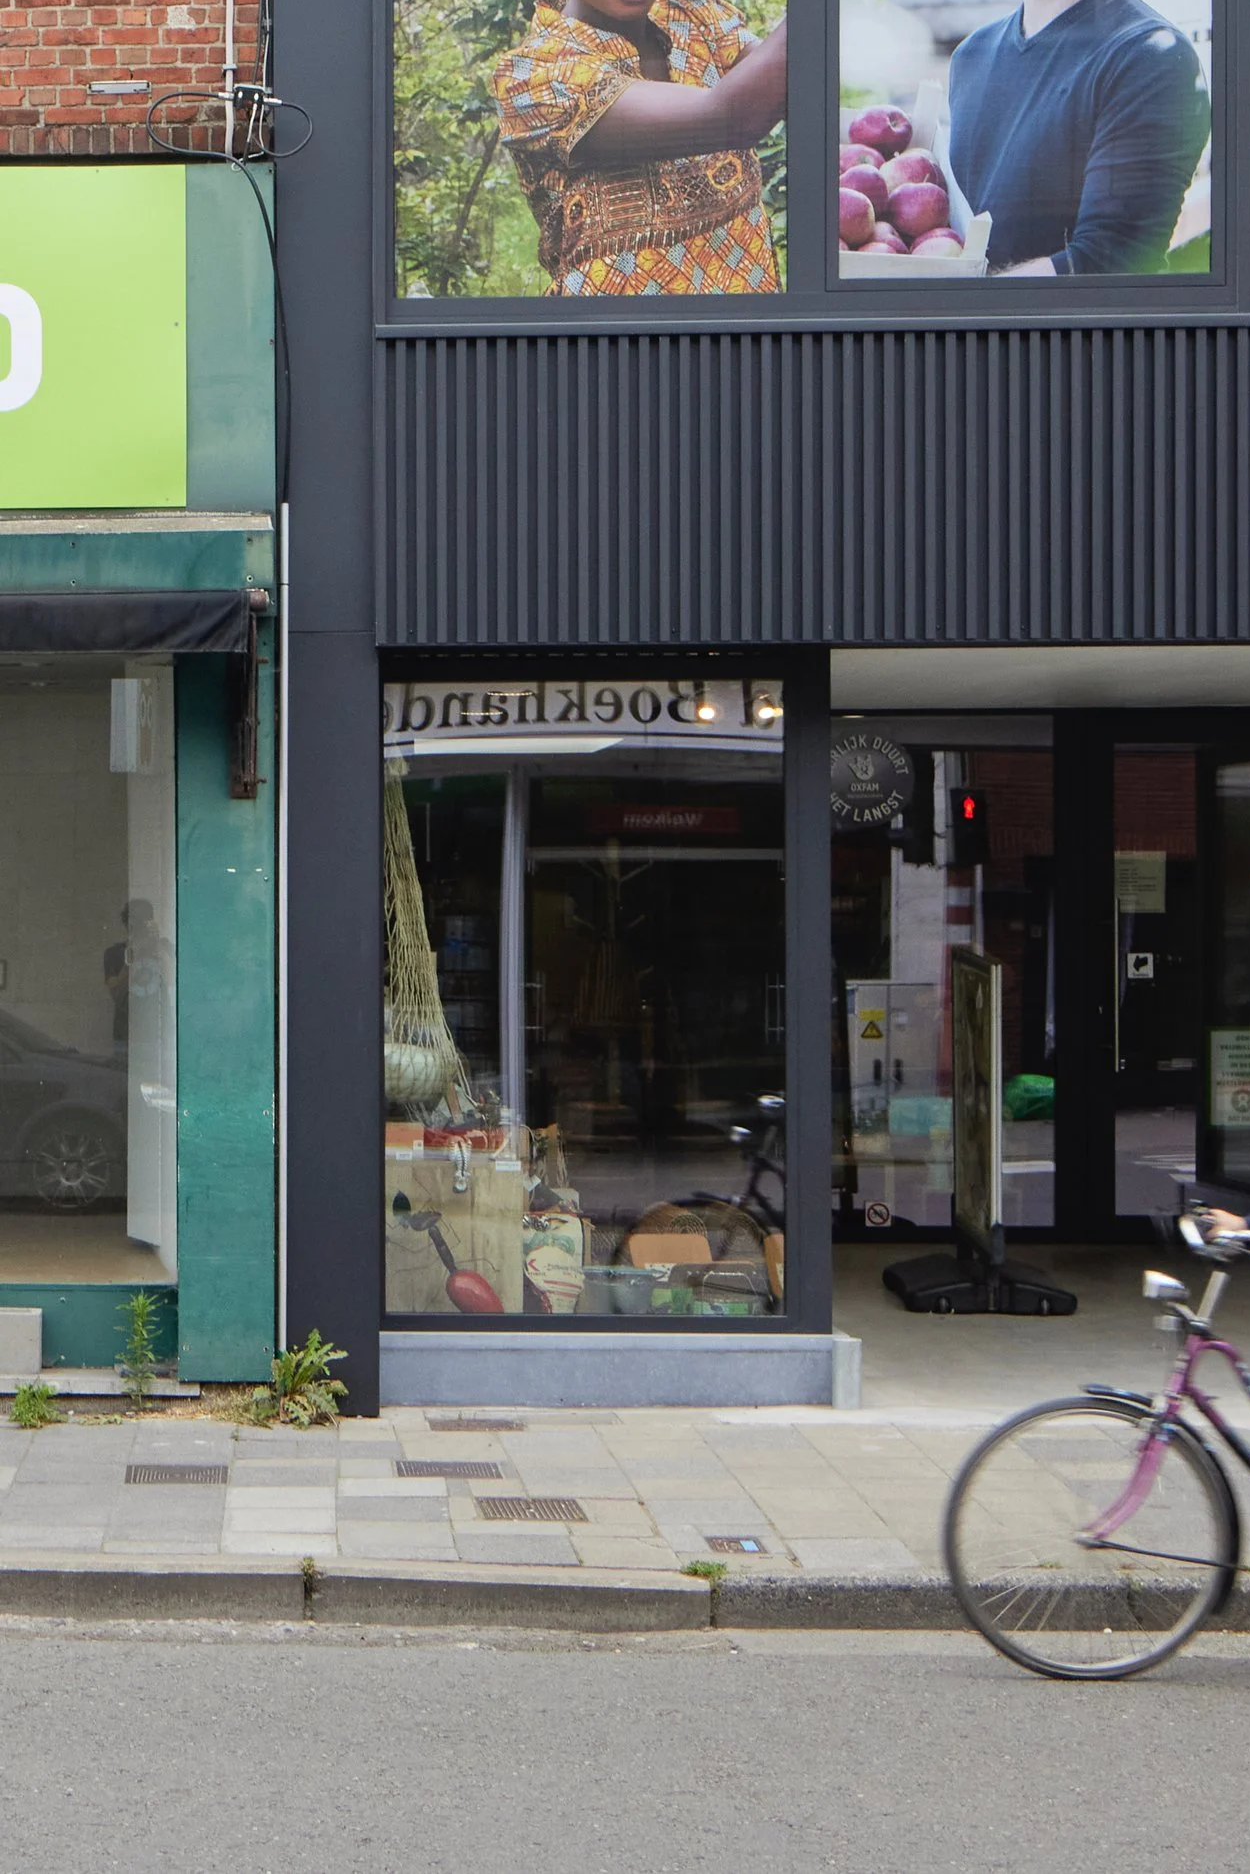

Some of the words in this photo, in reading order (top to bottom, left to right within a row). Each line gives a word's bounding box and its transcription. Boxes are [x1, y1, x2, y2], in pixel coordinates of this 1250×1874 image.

[873, 736, 909, 774] DUURT
[850, 783, 879, 792] OXFAM
[853, 790, 904, 822] LANGST
